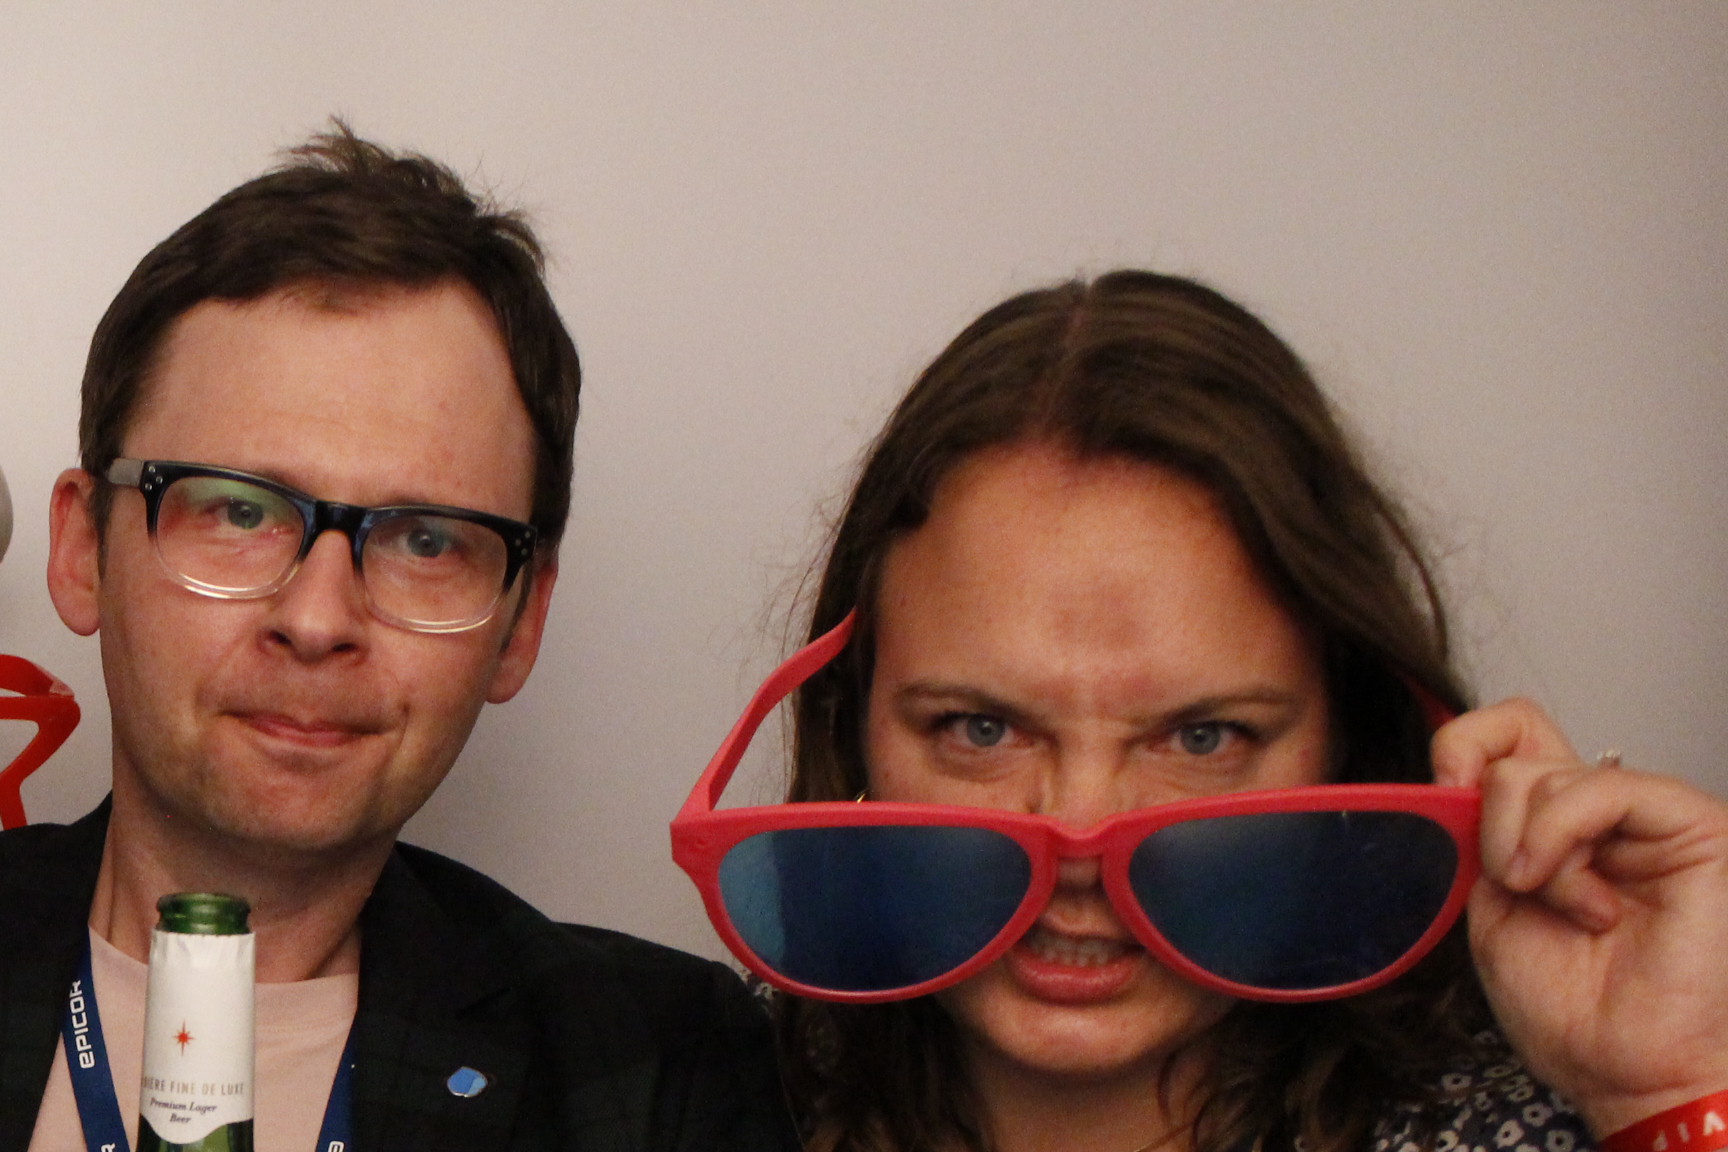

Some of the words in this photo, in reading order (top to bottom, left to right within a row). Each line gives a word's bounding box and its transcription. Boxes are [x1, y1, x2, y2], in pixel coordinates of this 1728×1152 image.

[170, 1080, 195, 1096] FINE
[201, 1083, 216, 1096] DE
[150, 1097, 187, 1111] Premium
[189, 1101, 218, 1115] Lager
[170, 1113, 192, 1124] Beer
[1652, 1110, 1726, 1152] VIP
